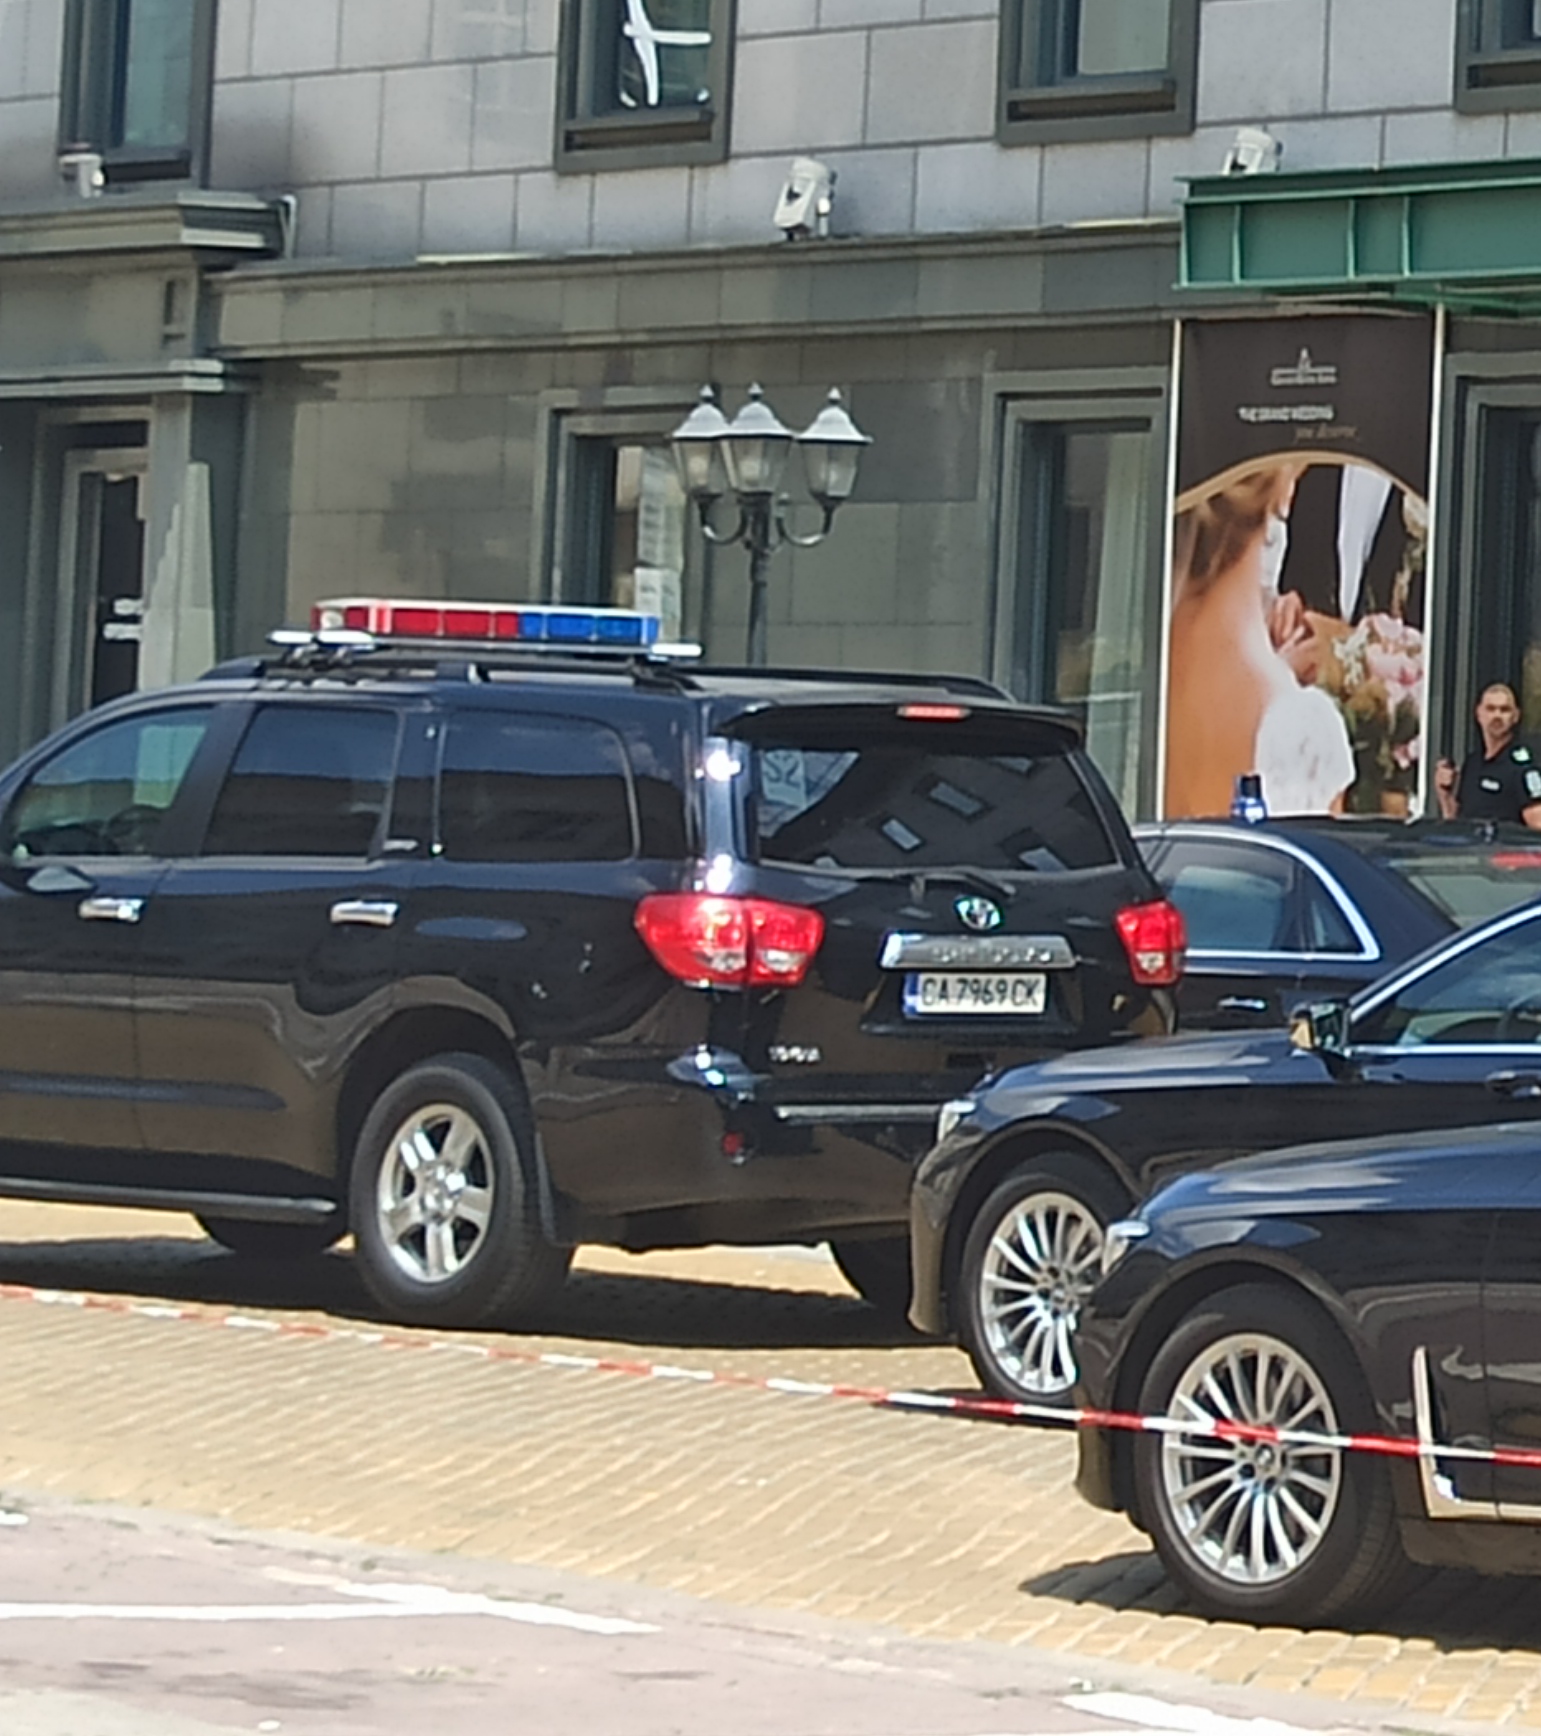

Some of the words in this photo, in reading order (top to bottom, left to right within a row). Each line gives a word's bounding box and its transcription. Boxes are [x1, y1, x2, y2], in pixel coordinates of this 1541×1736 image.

[922, 978, 949, 1006] CA
[957, 978, 1008, 1005] 7969
[1012, 979, 1040, 1006] CK
